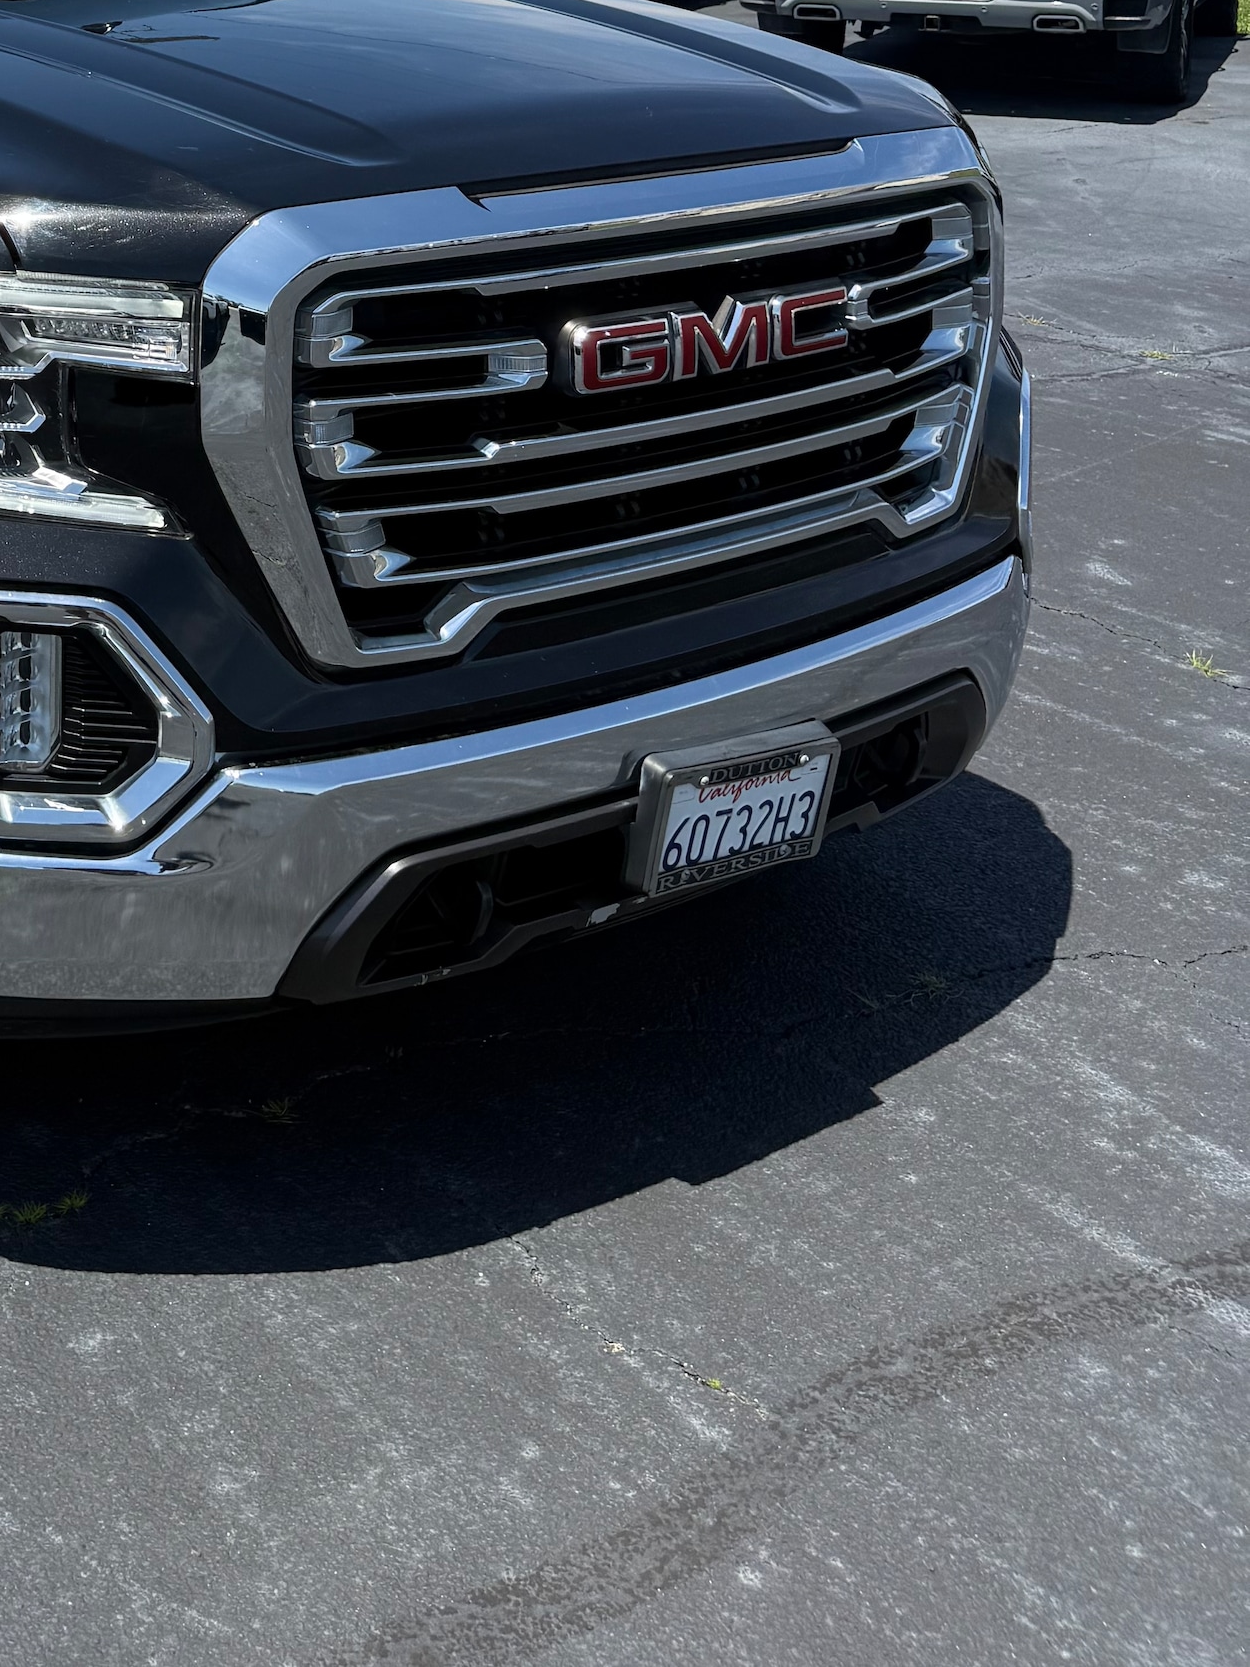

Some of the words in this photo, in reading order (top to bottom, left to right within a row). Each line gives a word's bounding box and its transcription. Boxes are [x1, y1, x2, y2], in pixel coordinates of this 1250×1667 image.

[568, 285, 850, 396] GMC
[698, 768, 802, 804] California
[710, 752, 801, 784] DUTTON
[662, 790, 815, 872] 60732H3
